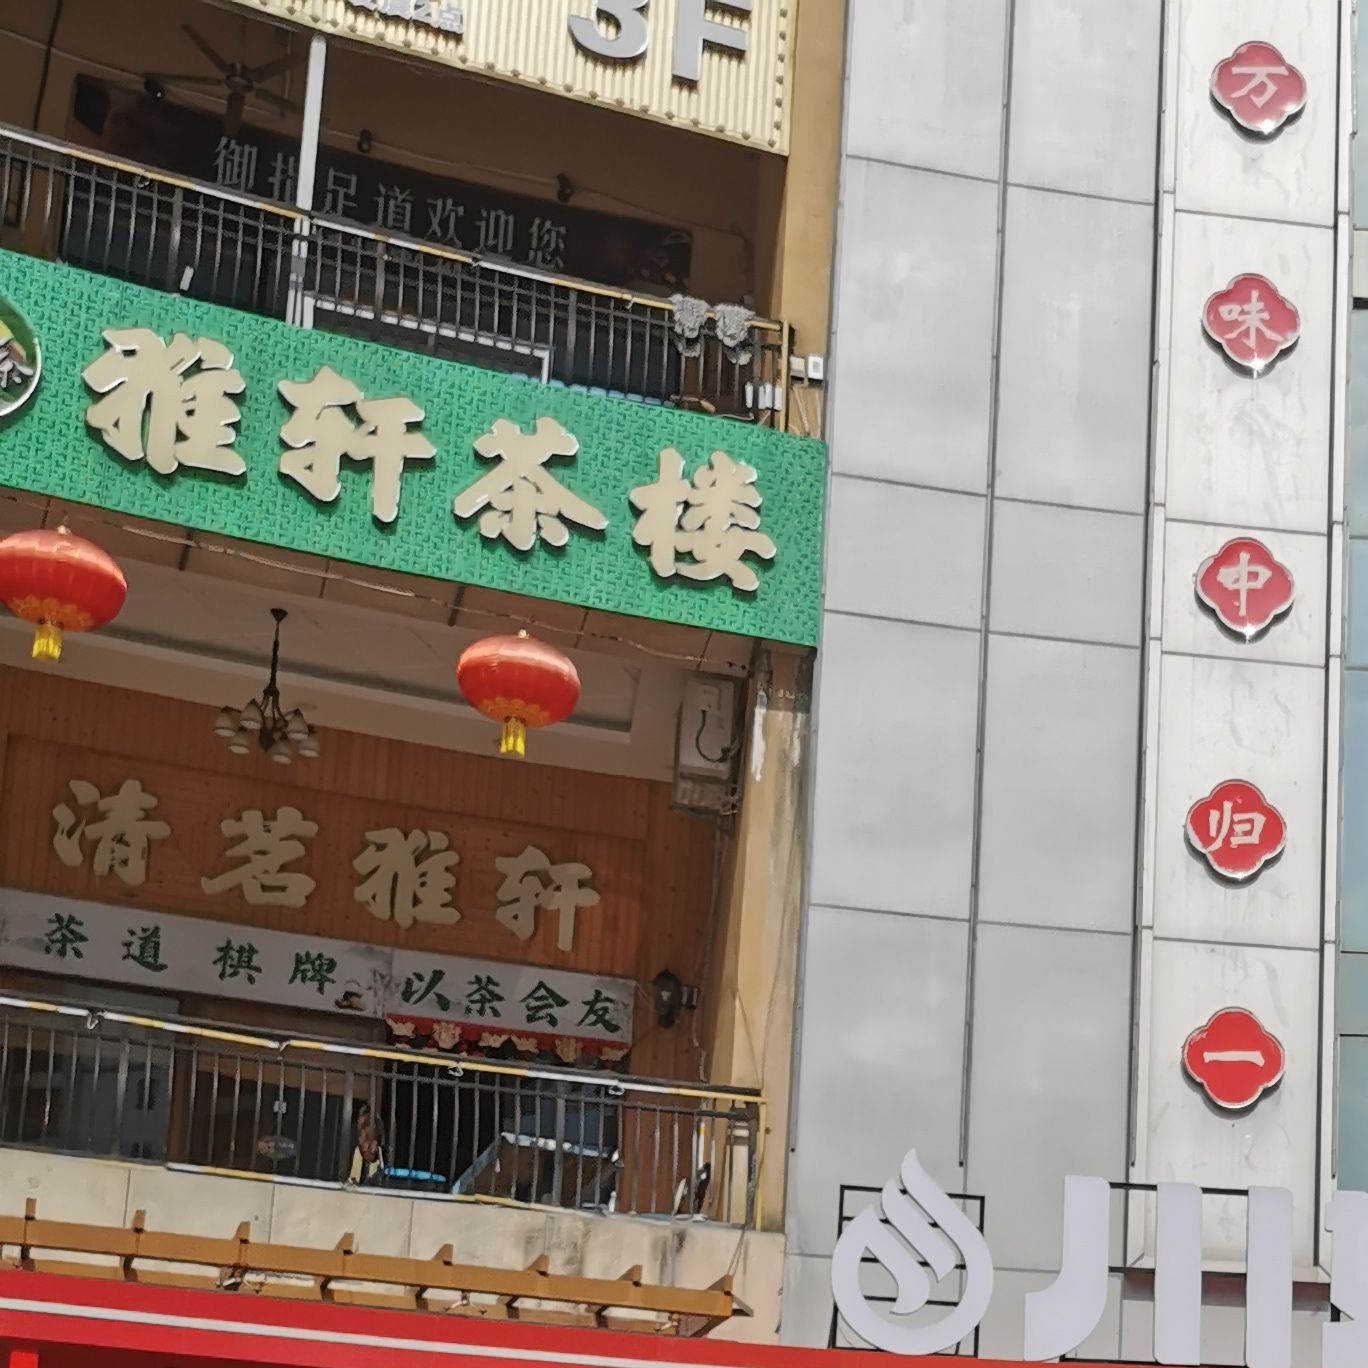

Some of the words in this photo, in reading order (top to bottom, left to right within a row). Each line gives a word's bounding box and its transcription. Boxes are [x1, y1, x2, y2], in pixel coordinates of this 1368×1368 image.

[569, 0, 752, 81] 3F
[83, 327, 776, 592] 雅轩茶楼
[53, 779, 600, 951] 清茗雅轩
[402, 969, 621, 1033] 以茶会友
